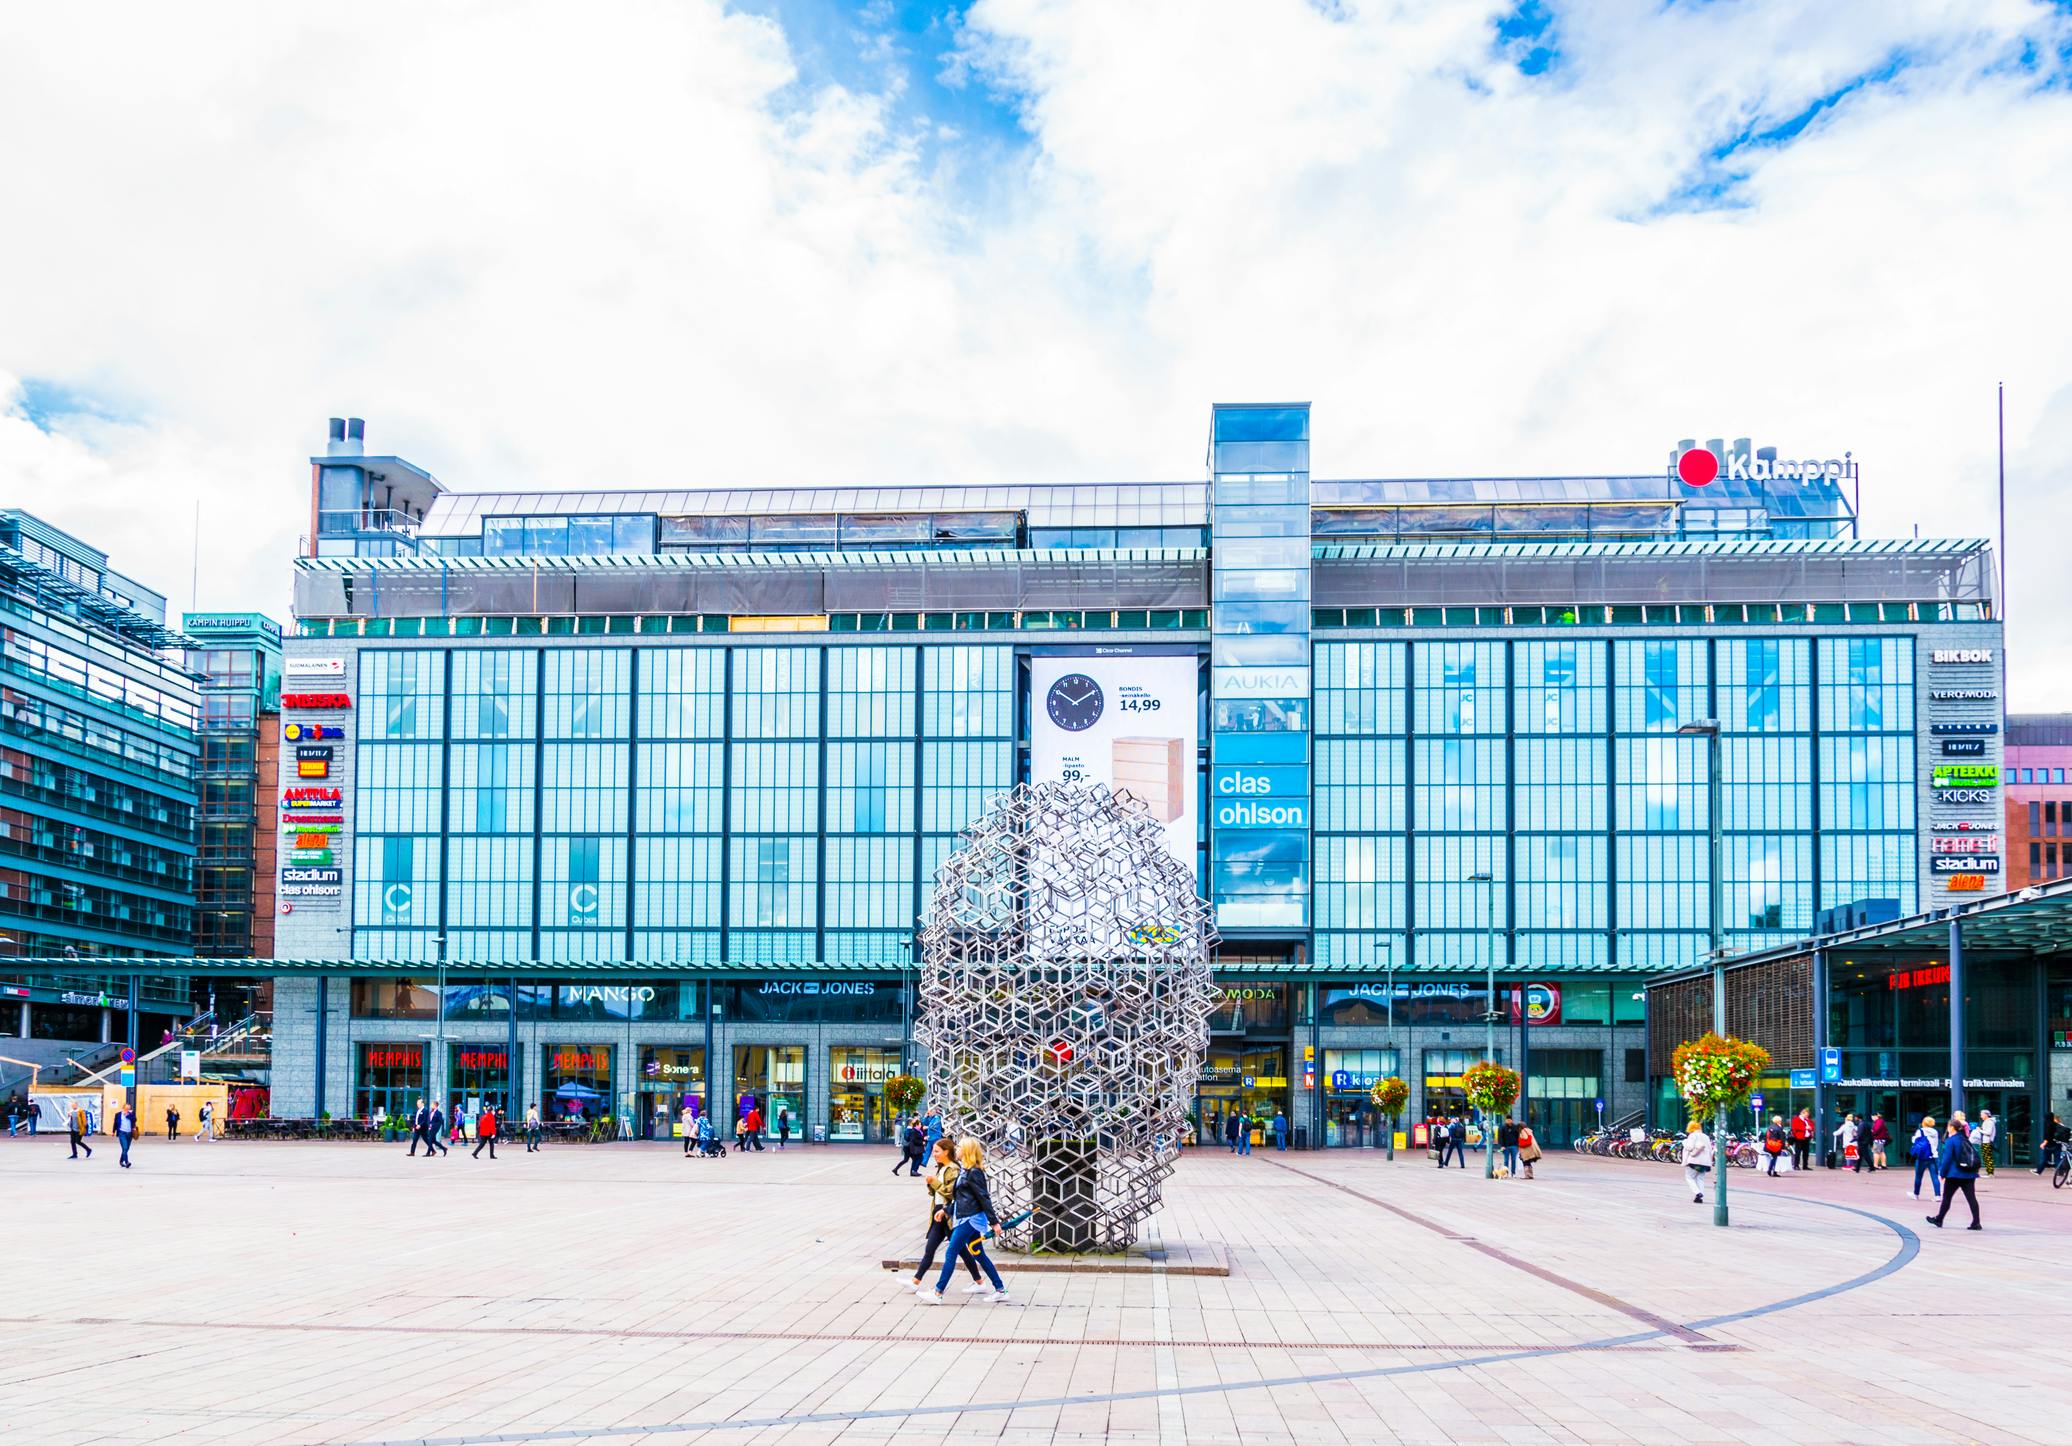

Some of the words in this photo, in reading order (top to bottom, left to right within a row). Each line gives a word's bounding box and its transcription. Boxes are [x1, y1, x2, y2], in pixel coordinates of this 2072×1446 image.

[1727, 451, 1853, 487] Kamppi
[187, 618, 218, 628] KAMPIN
[1223, 675, 1298, 689] AUKIA
[1120, 699, 1161, 713] 14,99
[1932, 765, 1999, 778] APTEEKKI
[1219, 771, 1271, 794] clas
[283, 787, 342, 800] ANTTILA
[1219, 803, 1303, 825] ohlson
[1935, 857, 1998, 870] stadium
[283, 868, 338, 881] stadium
[280, 884, 301, 895] clas
[569, 985, 655, 1001] MANGO
[759, 982, 802, 994] JACK
[822, 982, 875, 995] JONES
[1414, 983, 1470, 996] JONES
[368, 1051, 422, 1067] MEMPHIS
[460, 1052, 507, 1068] MEMPHI
[553, 1053, 608, 1069] MEMPHIS
[663, 1064, 699, 1074] Sonera
[1900, 1079, 1940, 1087] terminaali
